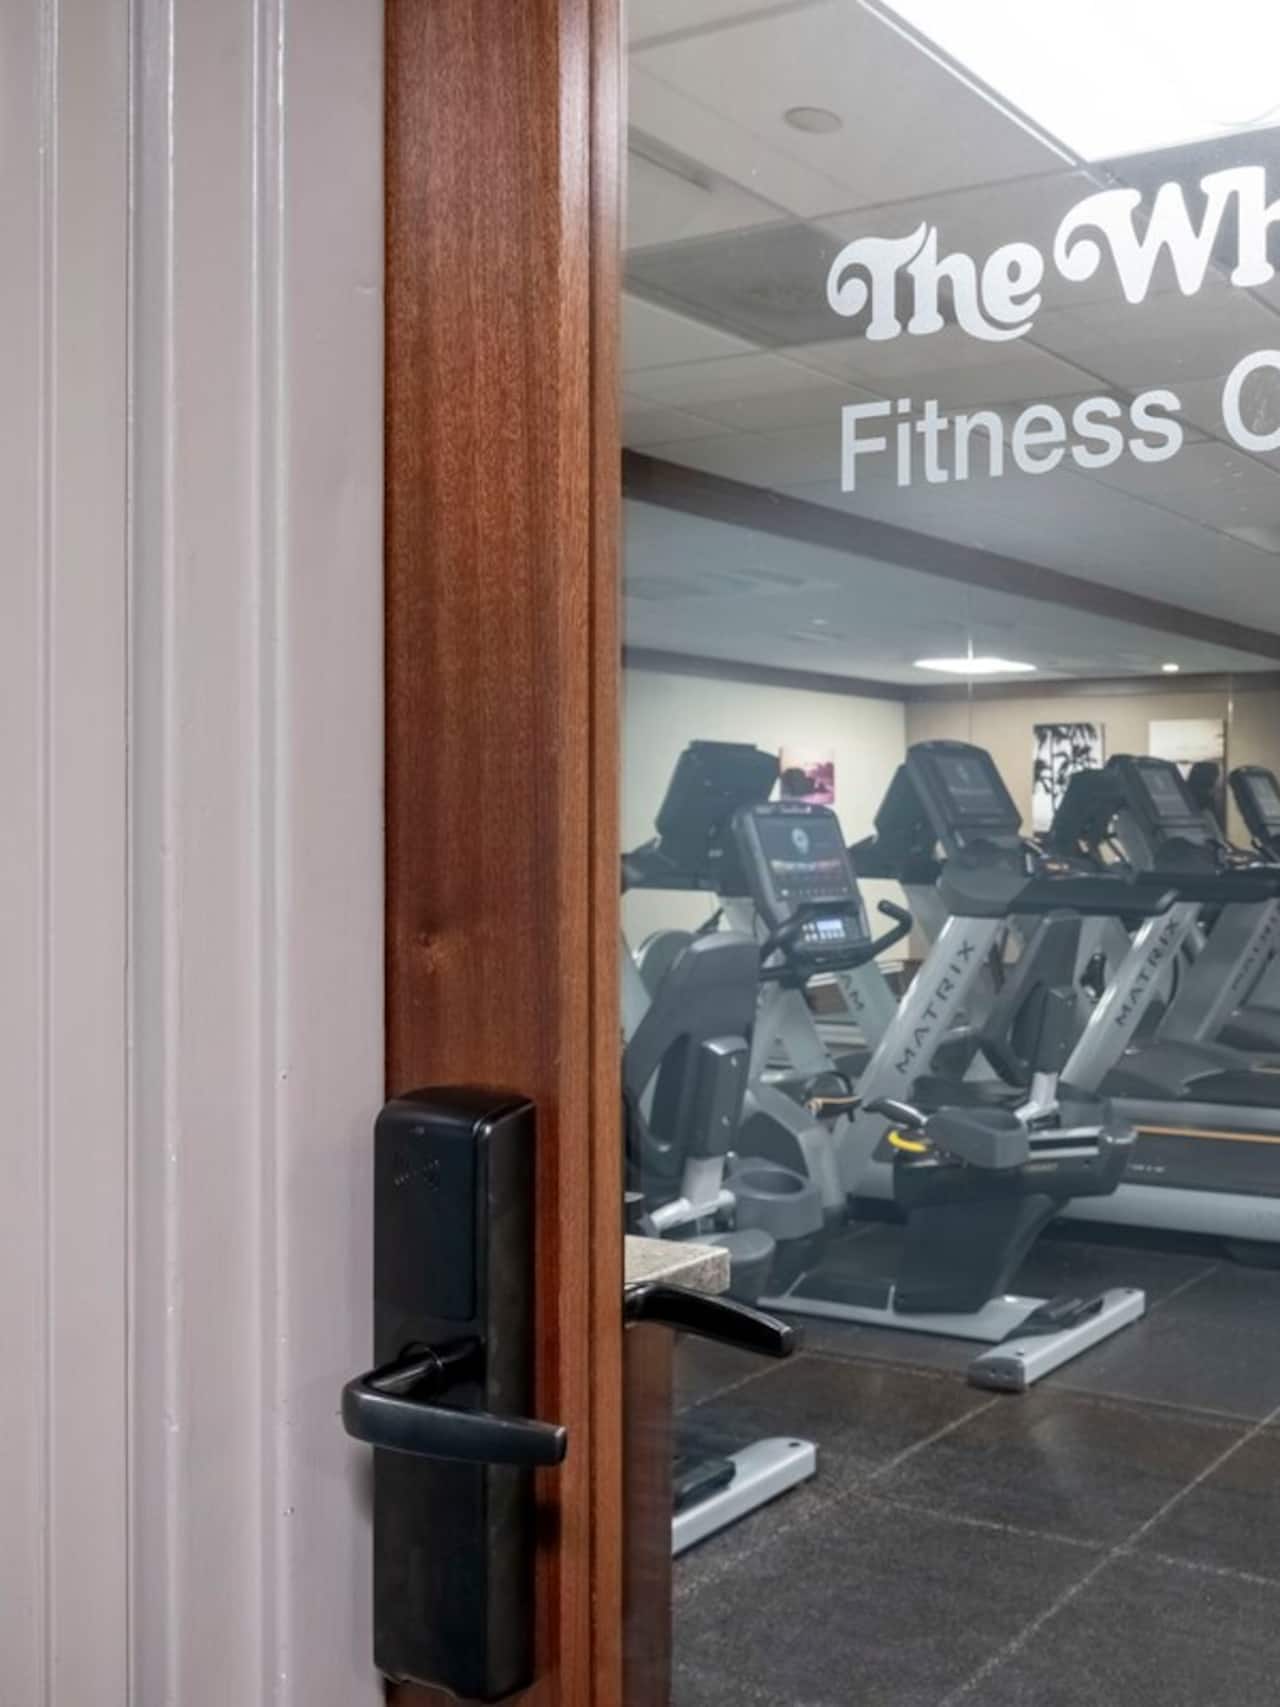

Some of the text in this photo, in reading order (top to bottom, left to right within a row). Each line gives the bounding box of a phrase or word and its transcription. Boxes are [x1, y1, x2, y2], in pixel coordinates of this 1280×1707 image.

[826, 221, 1044, 341] The
[839, 388, 1184, 493] Fitness
[895, 939, 975, 1074] MATRIX
[1114, 919, 1180, 1026] MATRIX
